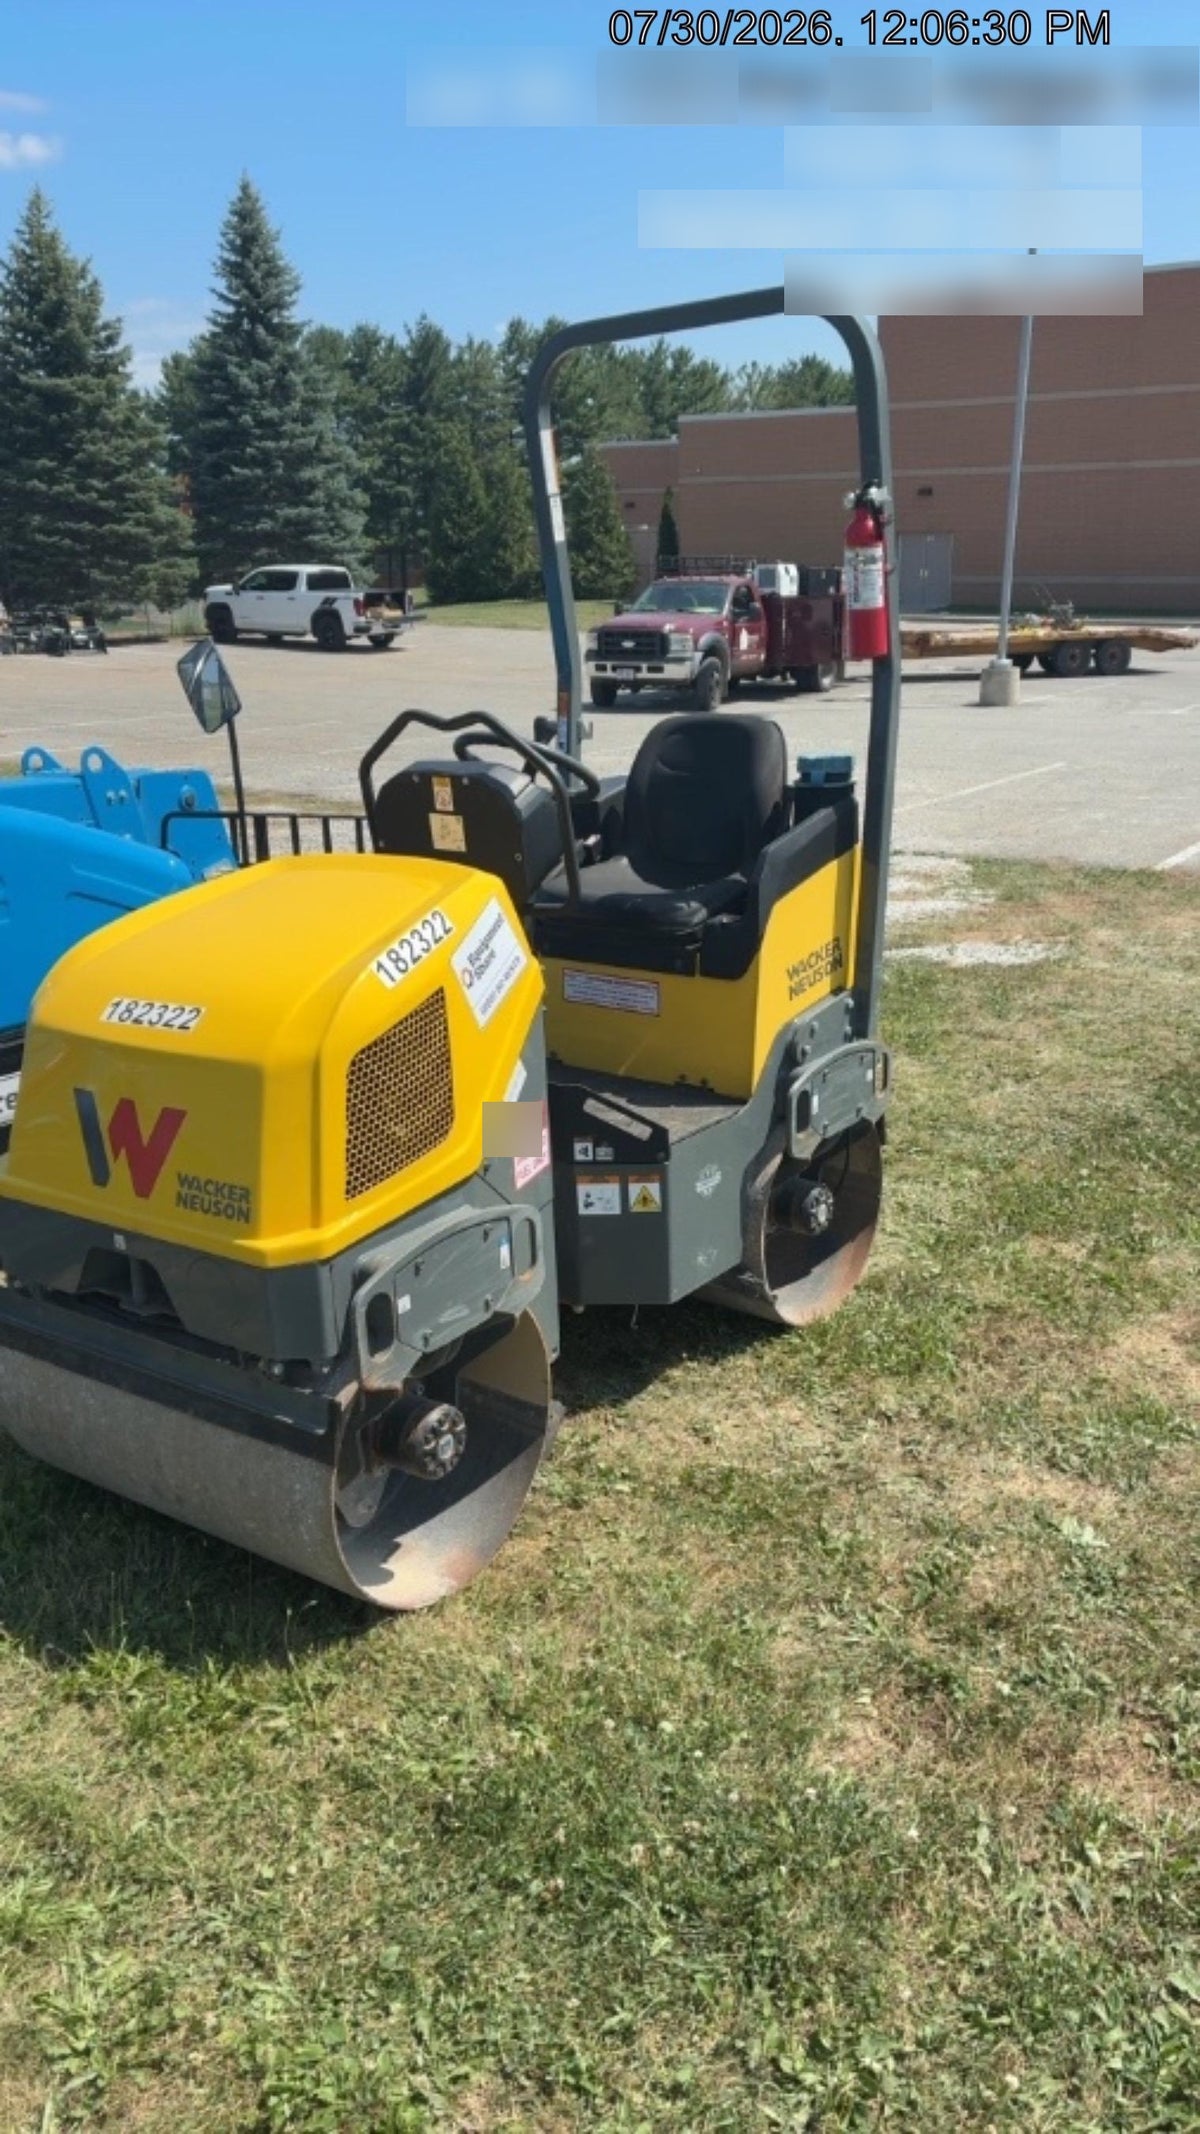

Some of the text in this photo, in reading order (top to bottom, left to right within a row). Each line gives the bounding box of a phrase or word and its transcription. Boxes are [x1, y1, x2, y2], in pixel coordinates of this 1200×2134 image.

[376, 910, 453, 982] 182322
[786, 936, 842, 981] WACKER
[789, 953, 843, 1001] NEUSON
[106, 999, 202, 1030] 182322
[175, 1191, 251, 1224] NEUSON
[177, 1173, 251, 1204] WACKER
